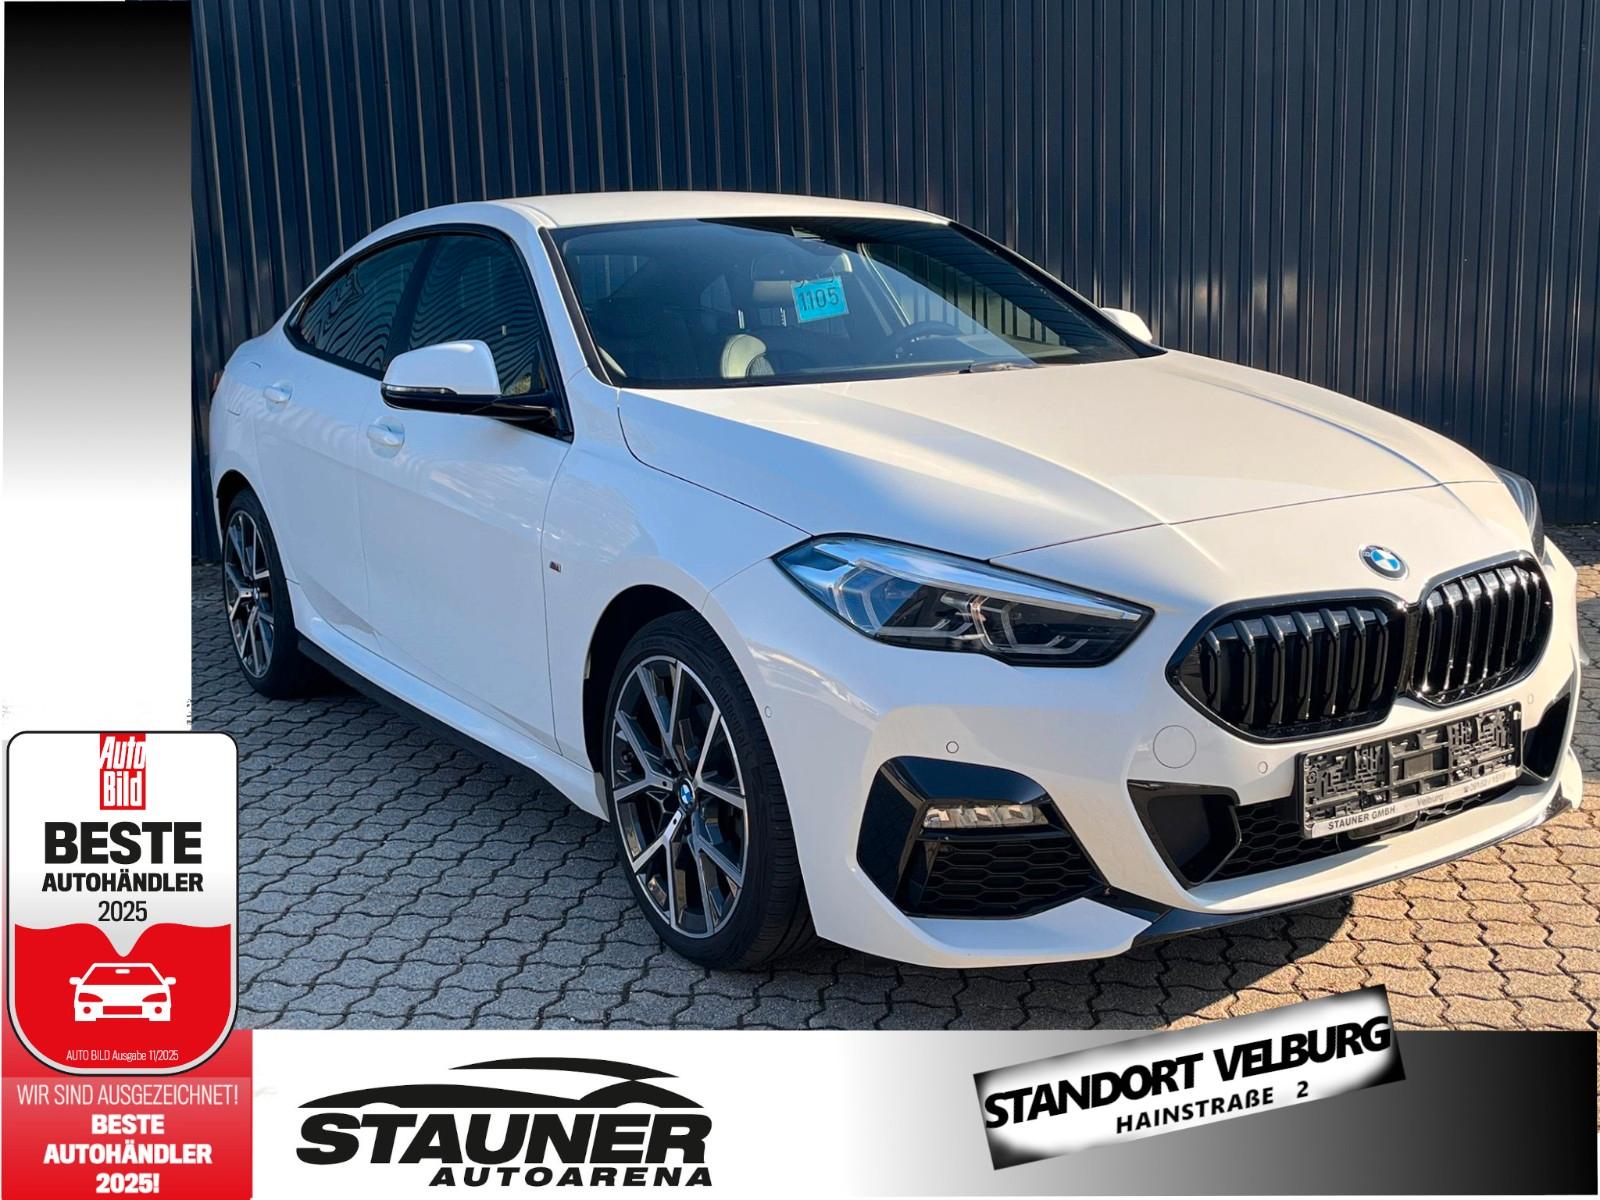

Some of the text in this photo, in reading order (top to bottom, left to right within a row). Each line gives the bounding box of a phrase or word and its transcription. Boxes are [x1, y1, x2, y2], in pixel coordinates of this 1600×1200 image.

[798, 286, 839, 311] 1105
[1328, 812, 1369, 831] STAUNER
[1371, 804, 1396, 820] GMBH
